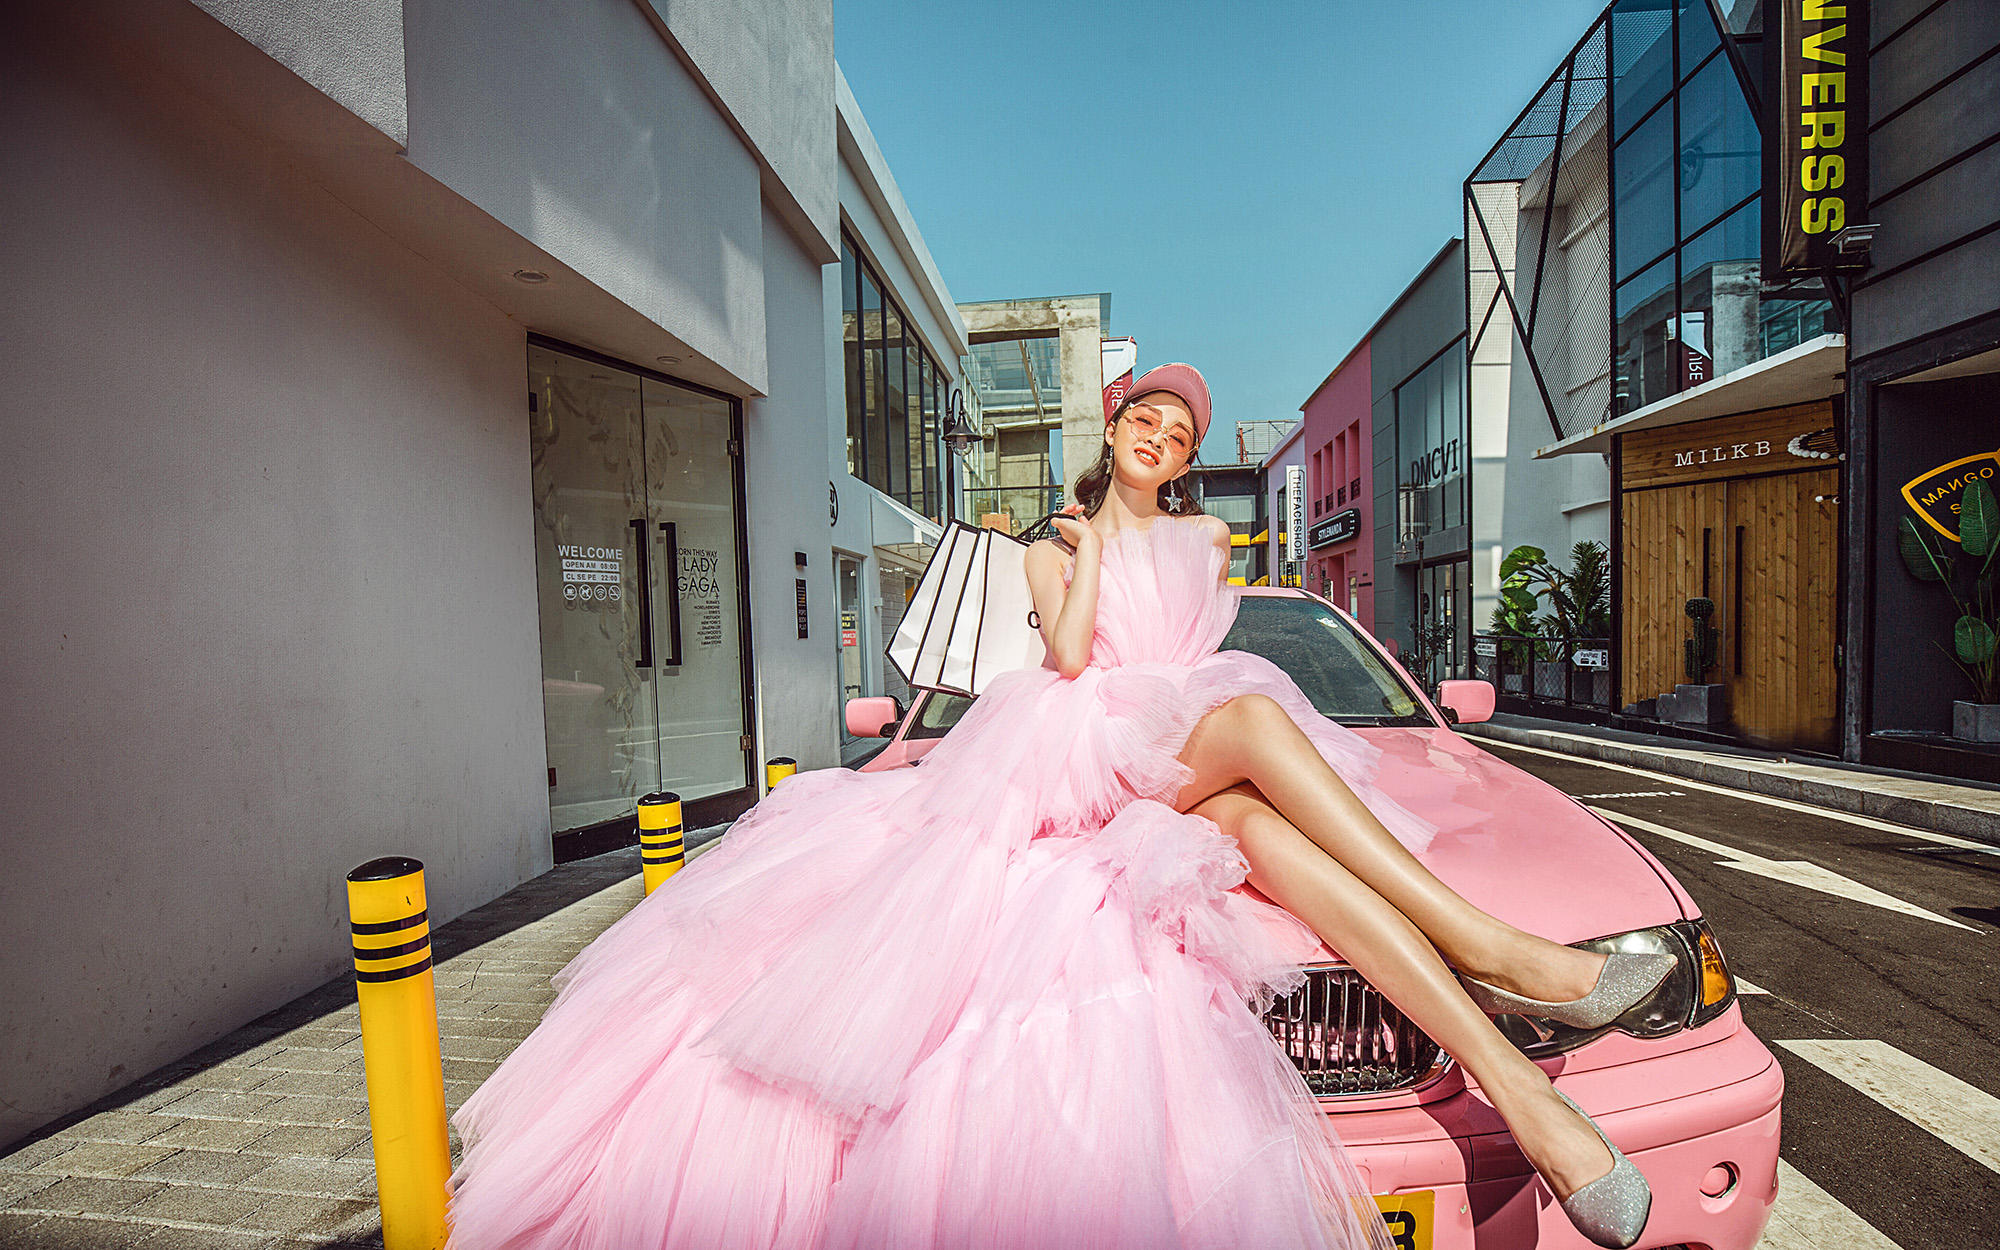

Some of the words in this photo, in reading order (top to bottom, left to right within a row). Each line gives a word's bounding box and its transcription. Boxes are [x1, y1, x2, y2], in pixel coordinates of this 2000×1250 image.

[1674, 440, 1771, 467] MILKB
[1411, 438, 1458, 490] DMCVI
[557, 544, 624, 560] WELCOME
[565, 561, 585, 569] OPEN
[683, 556, 719, 573] LADY
[677, 576, 720, 592] GAGA
